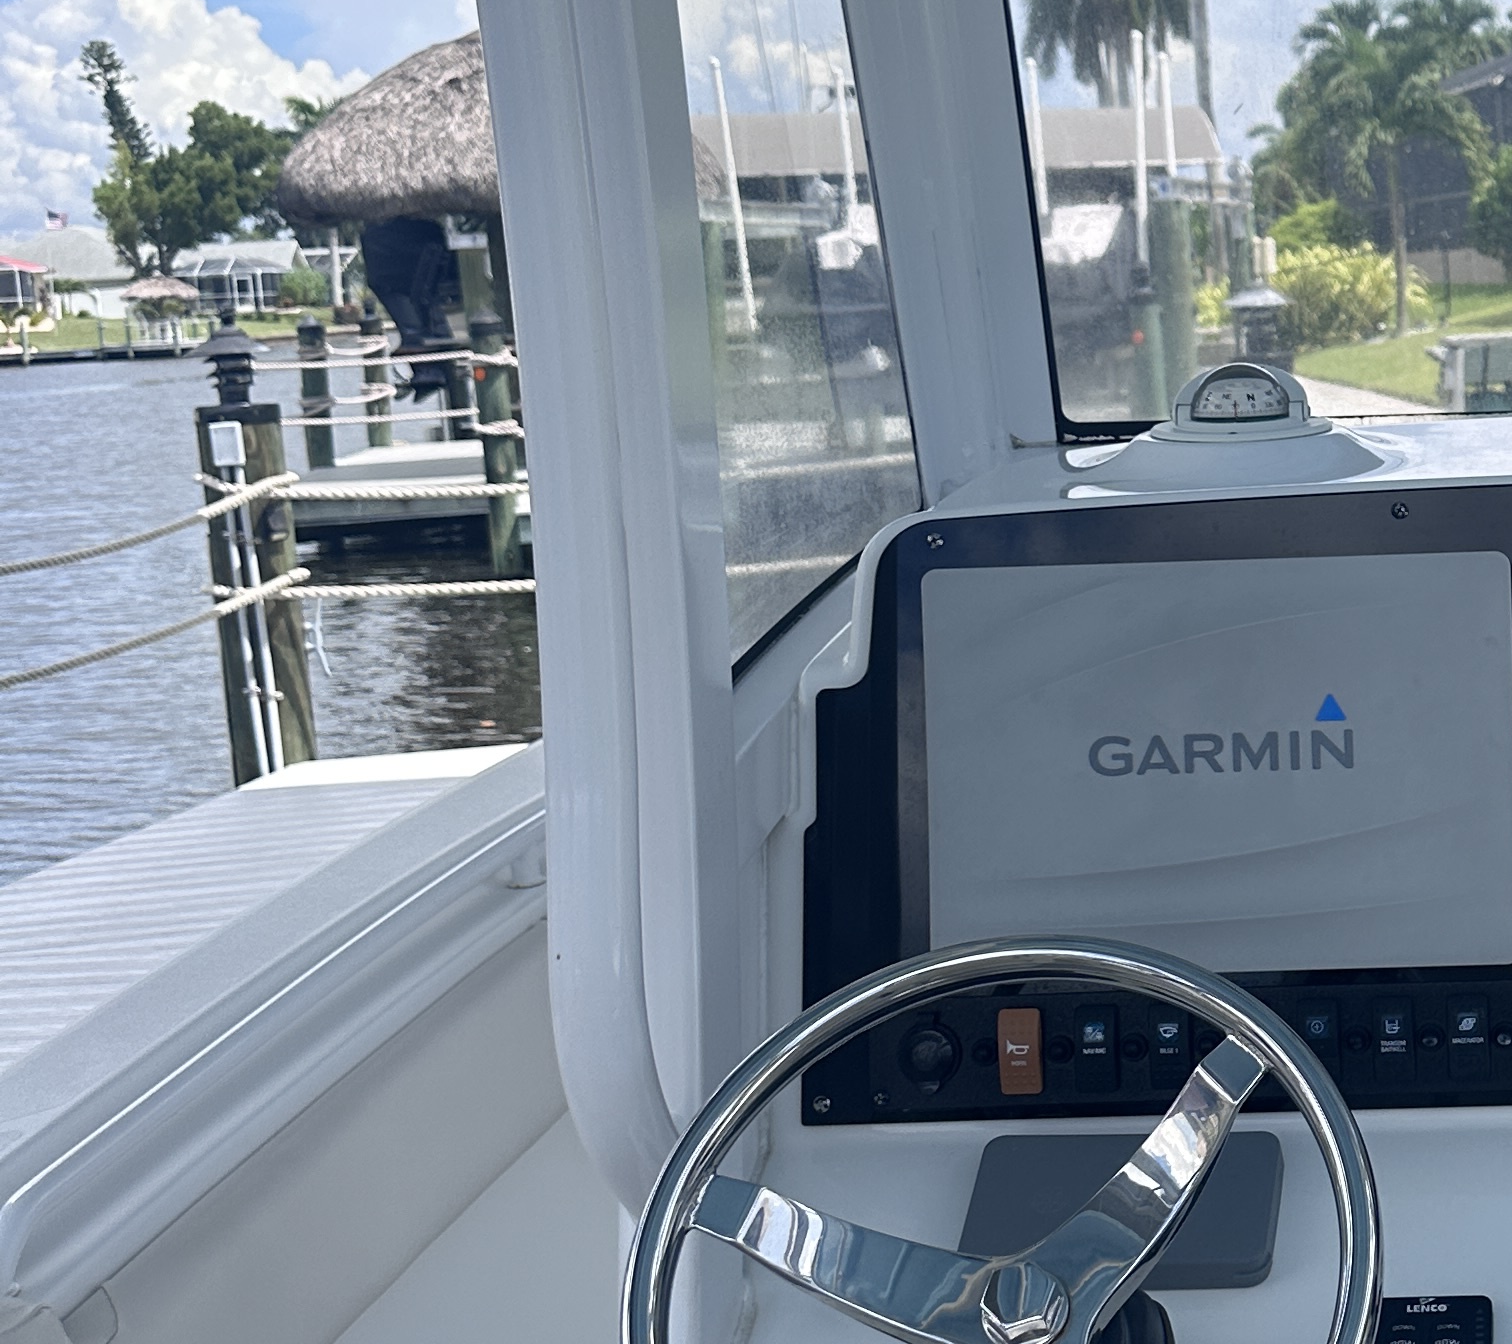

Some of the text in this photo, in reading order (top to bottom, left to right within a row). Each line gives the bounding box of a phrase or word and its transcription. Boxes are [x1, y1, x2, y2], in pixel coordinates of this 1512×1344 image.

[1246, 393, 1256, 402] N
[1089, 728, 1354, 777] GARMIN
[1406, 1304, 1448, 1313] LENCO
[1436, 1323, 1460, 1331] DOWN
